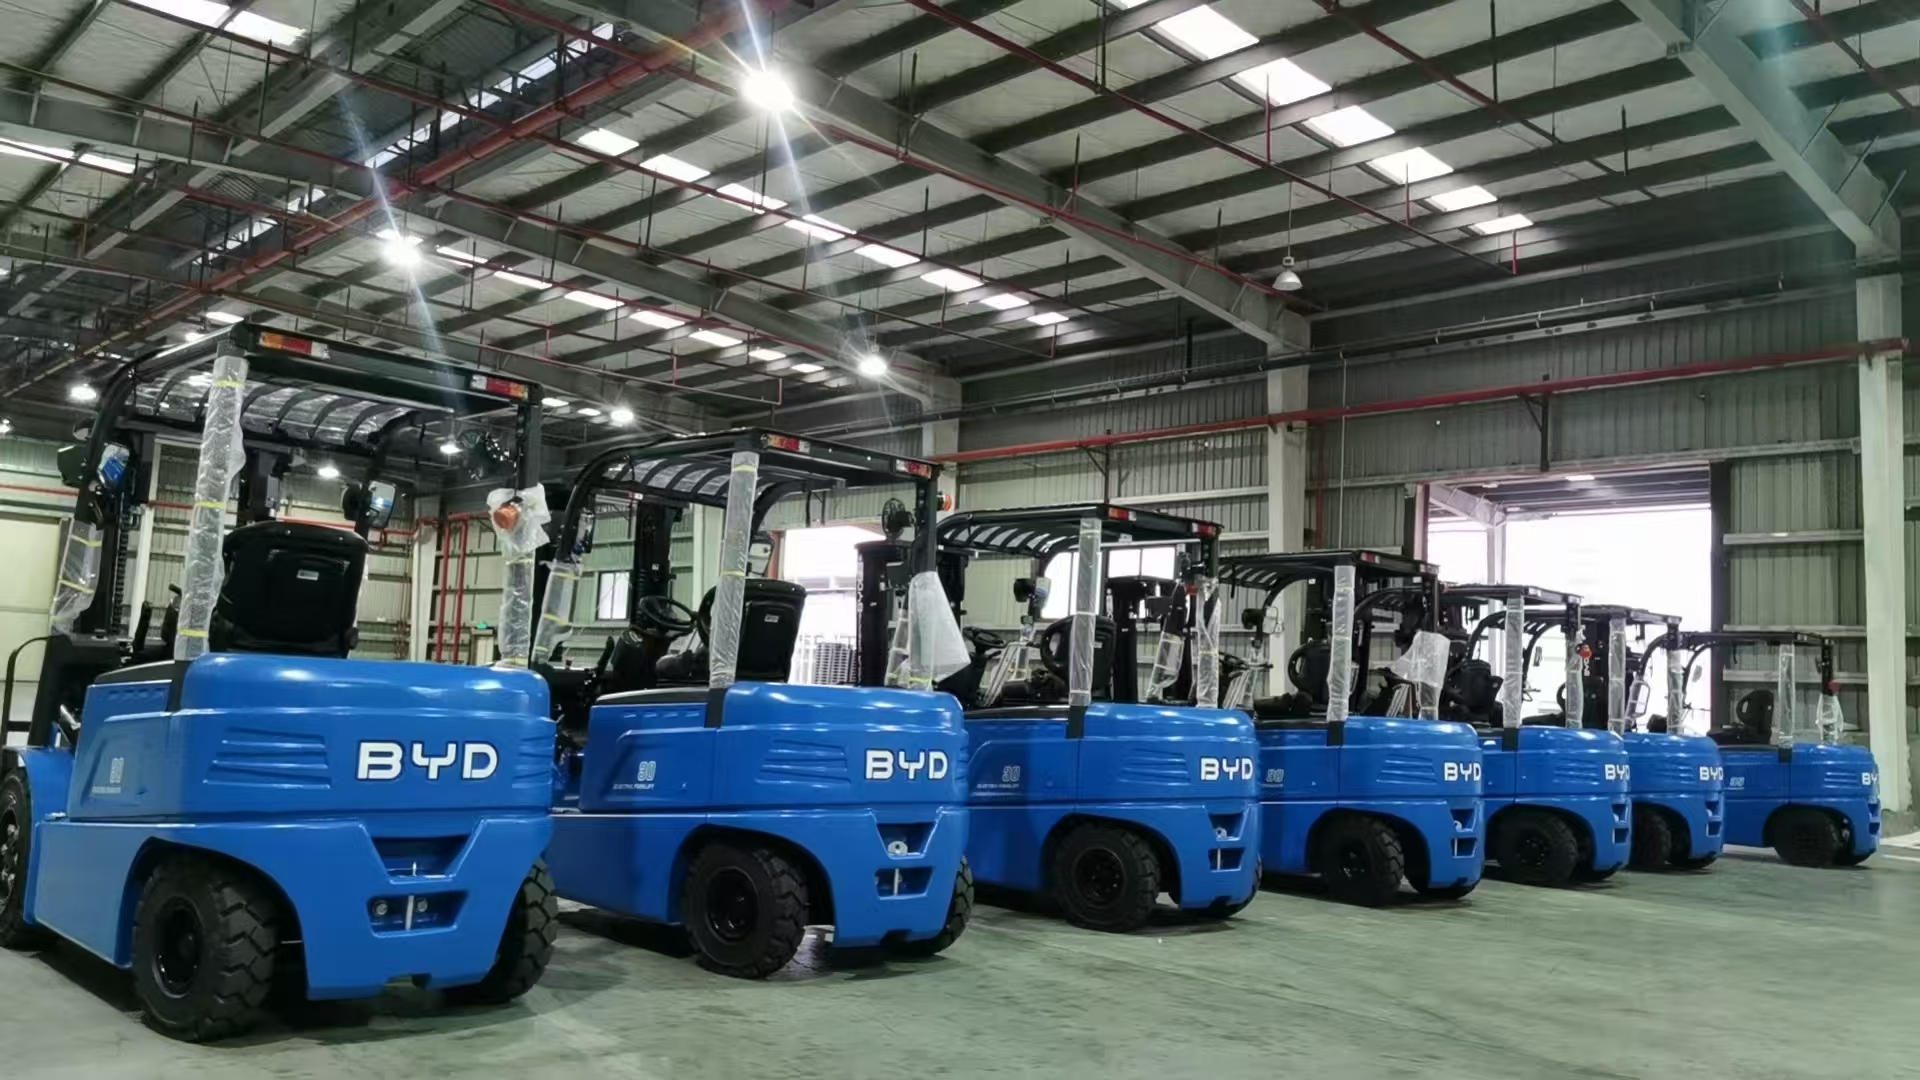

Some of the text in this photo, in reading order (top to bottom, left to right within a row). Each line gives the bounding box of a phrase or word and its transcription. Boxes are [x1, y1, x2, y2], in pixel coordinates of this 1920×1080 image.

[356, 741, 498, 780] BYD
[865, 749, 948, 780] BYD
[1200, 757, 1254, 781] BYD
[1444, 762, 1482, 782] BYD
[1604, 764, 1631, 781] BYD
[1699, 766, 1724, 781] BYD
